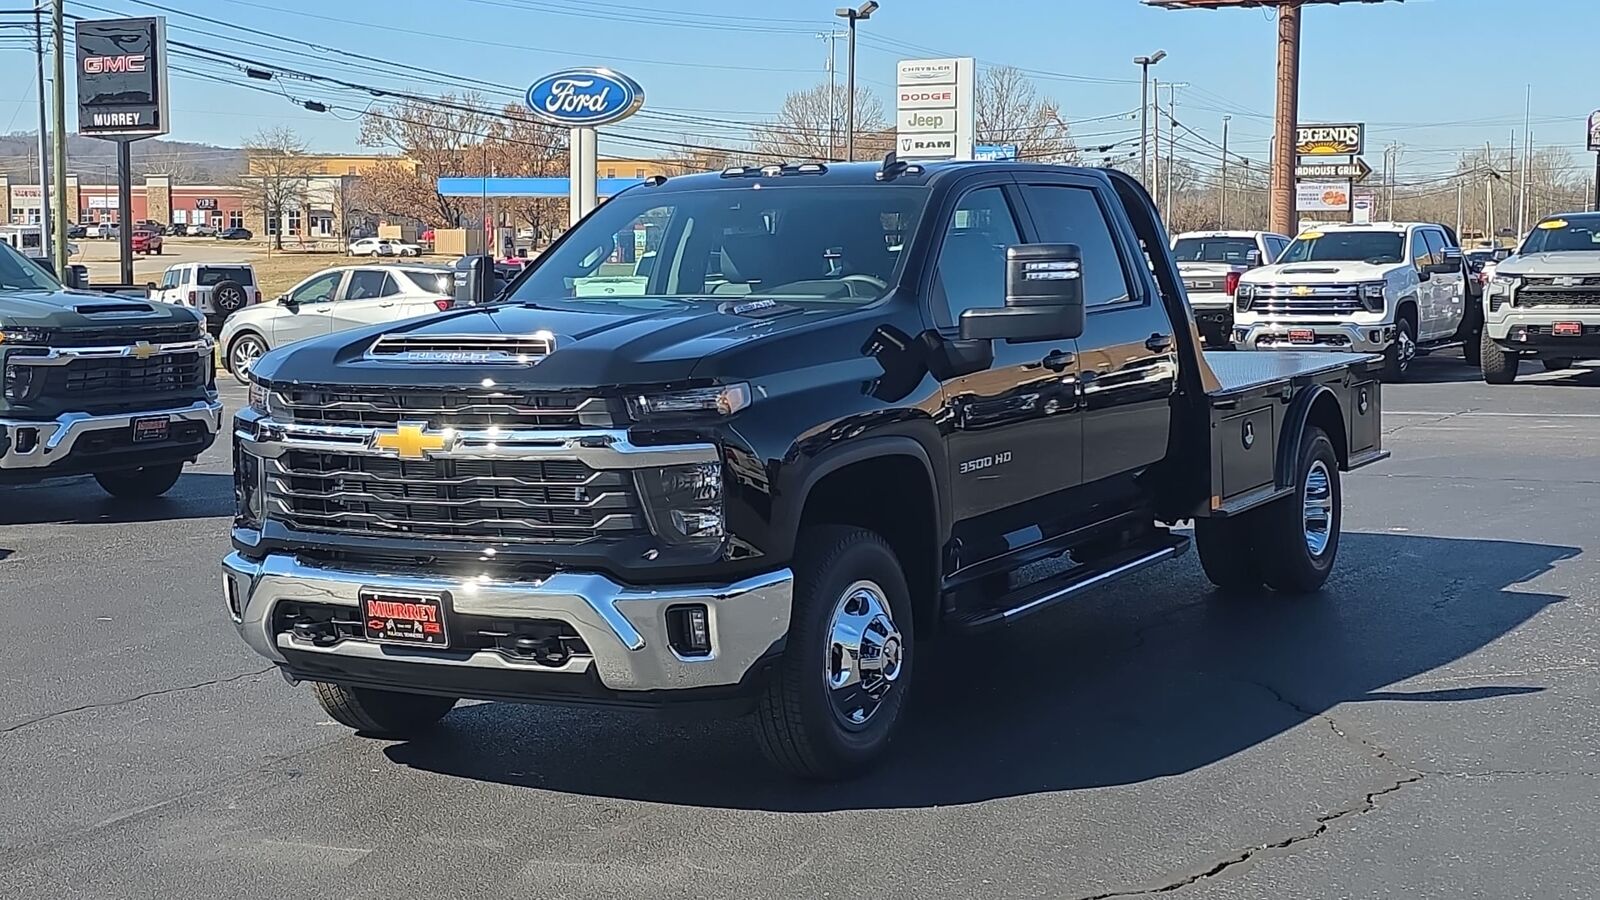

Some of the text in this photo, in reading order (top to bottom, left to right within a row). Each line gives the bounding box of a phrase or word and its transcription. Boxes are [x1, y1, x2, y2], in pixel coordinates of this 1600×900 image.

[84, 55, 146, 73] GMC
[545, 79, 610, 112] Ford
[901, 92, 951, 101] DODGE
[93, 112, 140, 126] MURREY
[908, 113, 943, 129] Jeep
[915, 141, 951, 149] RAM
[1337, 165, 1361, 175] GRILL
[960, 451, 1012, 474] 3500 HD
[367, 600, 436, 622] MURREY
